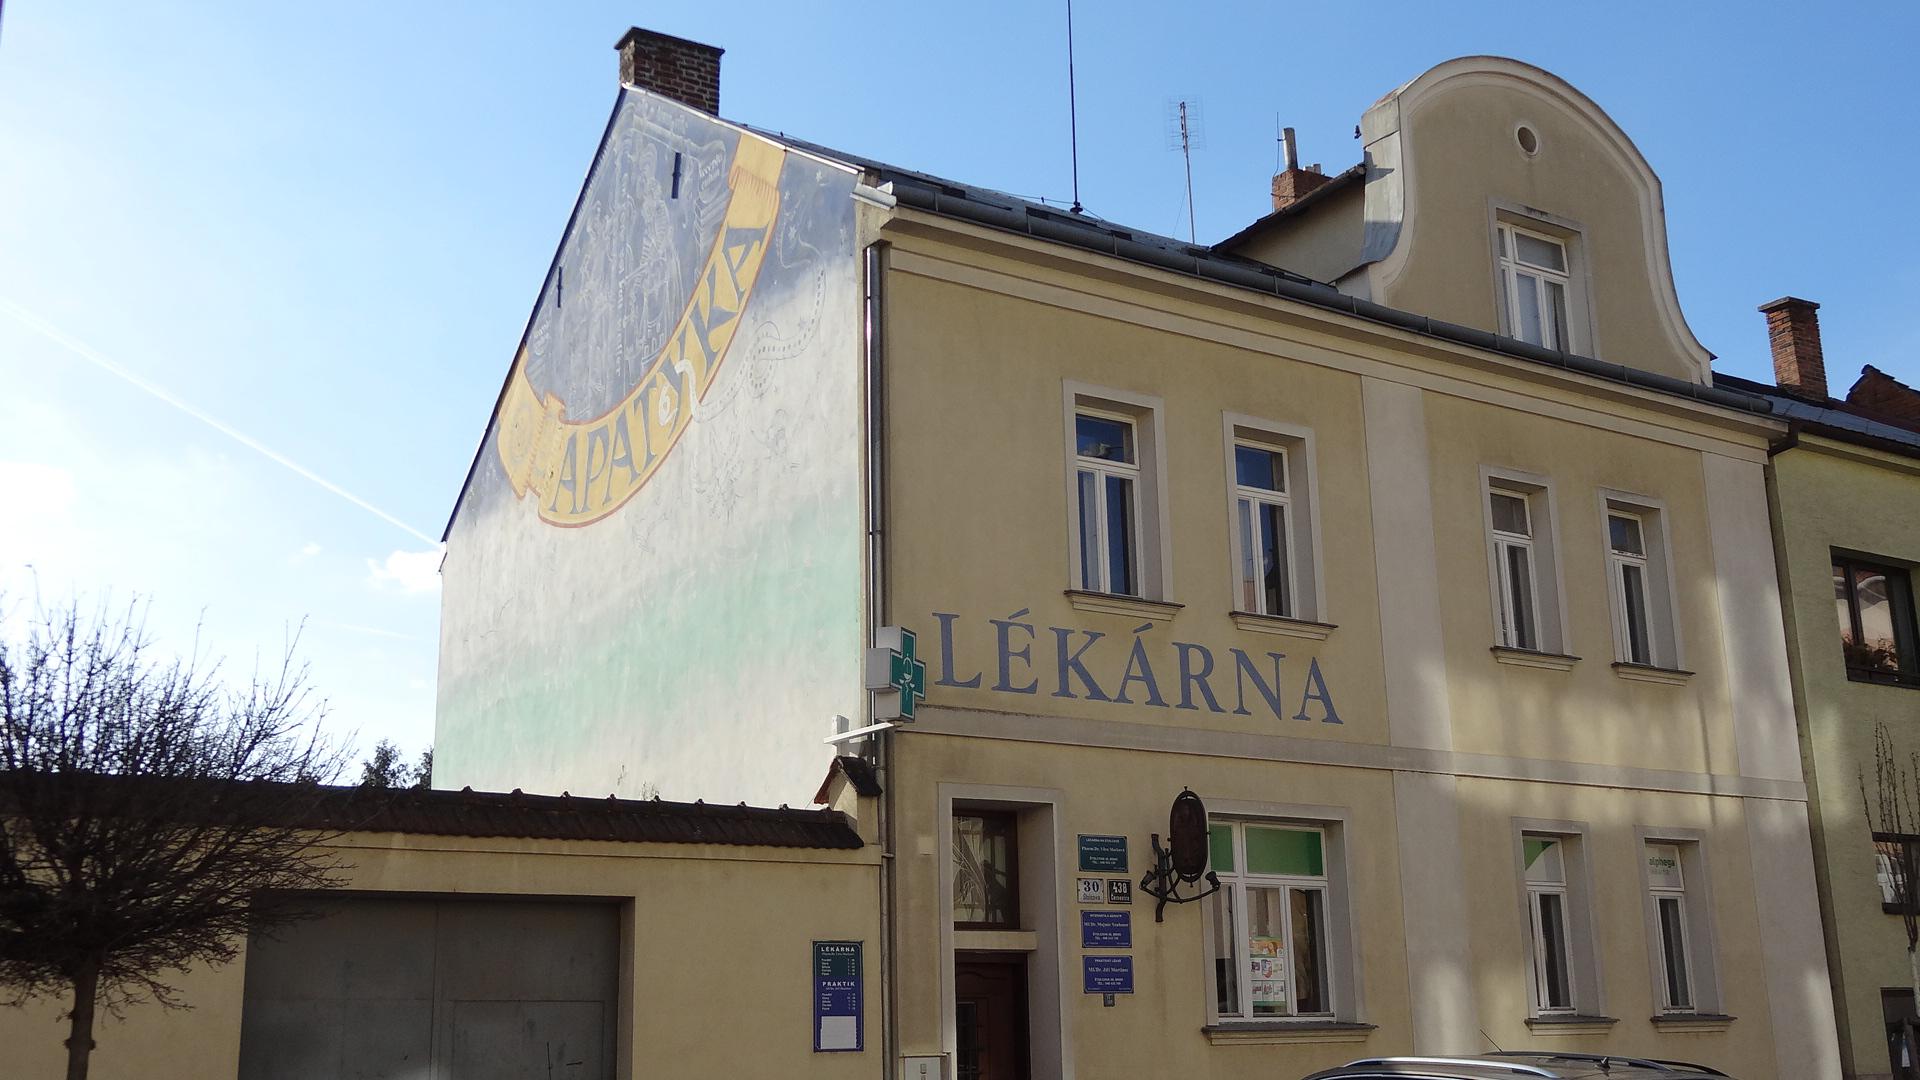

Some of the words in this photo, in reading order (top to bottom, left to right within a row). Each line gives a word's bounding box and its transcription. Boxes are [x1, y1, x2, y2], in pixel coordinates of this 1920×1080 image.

[550, 224, 772, 514] APATYKA
[931, 607, 1344, 725] LÉKÁRNA
[1084, 880, 1099, 892] 30
